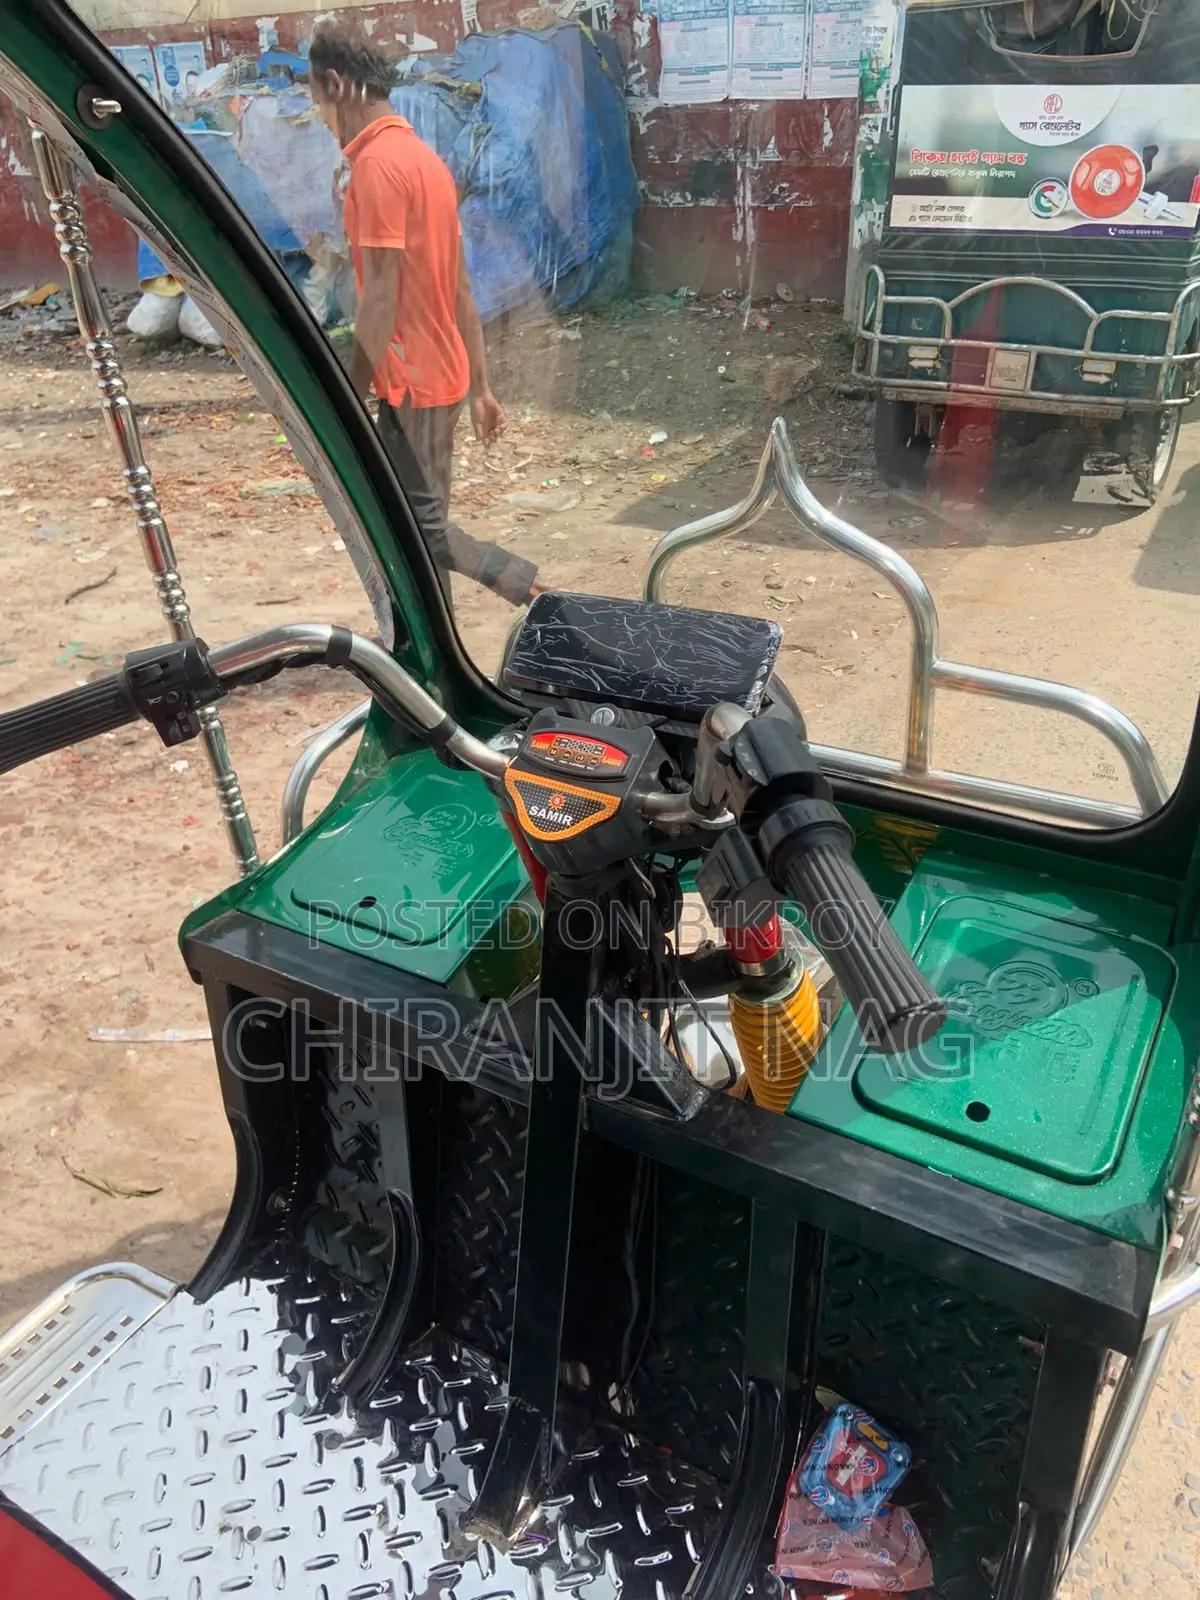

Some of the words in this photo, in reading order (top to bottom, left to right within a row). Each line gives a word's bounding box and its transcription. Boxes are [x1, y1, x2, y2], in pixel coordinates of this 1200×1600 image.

[1019, 121, 1038, 132] গ্যাস
[1040, 120, 1082, 132] রেগুলেটর
[910, 148, 947, 164] লিকেজ
[950, 149, 979, 165] হলেই
[981, 152, 1005, 165] গ্যাস
[528, 805, 573, 826] SAMIR
